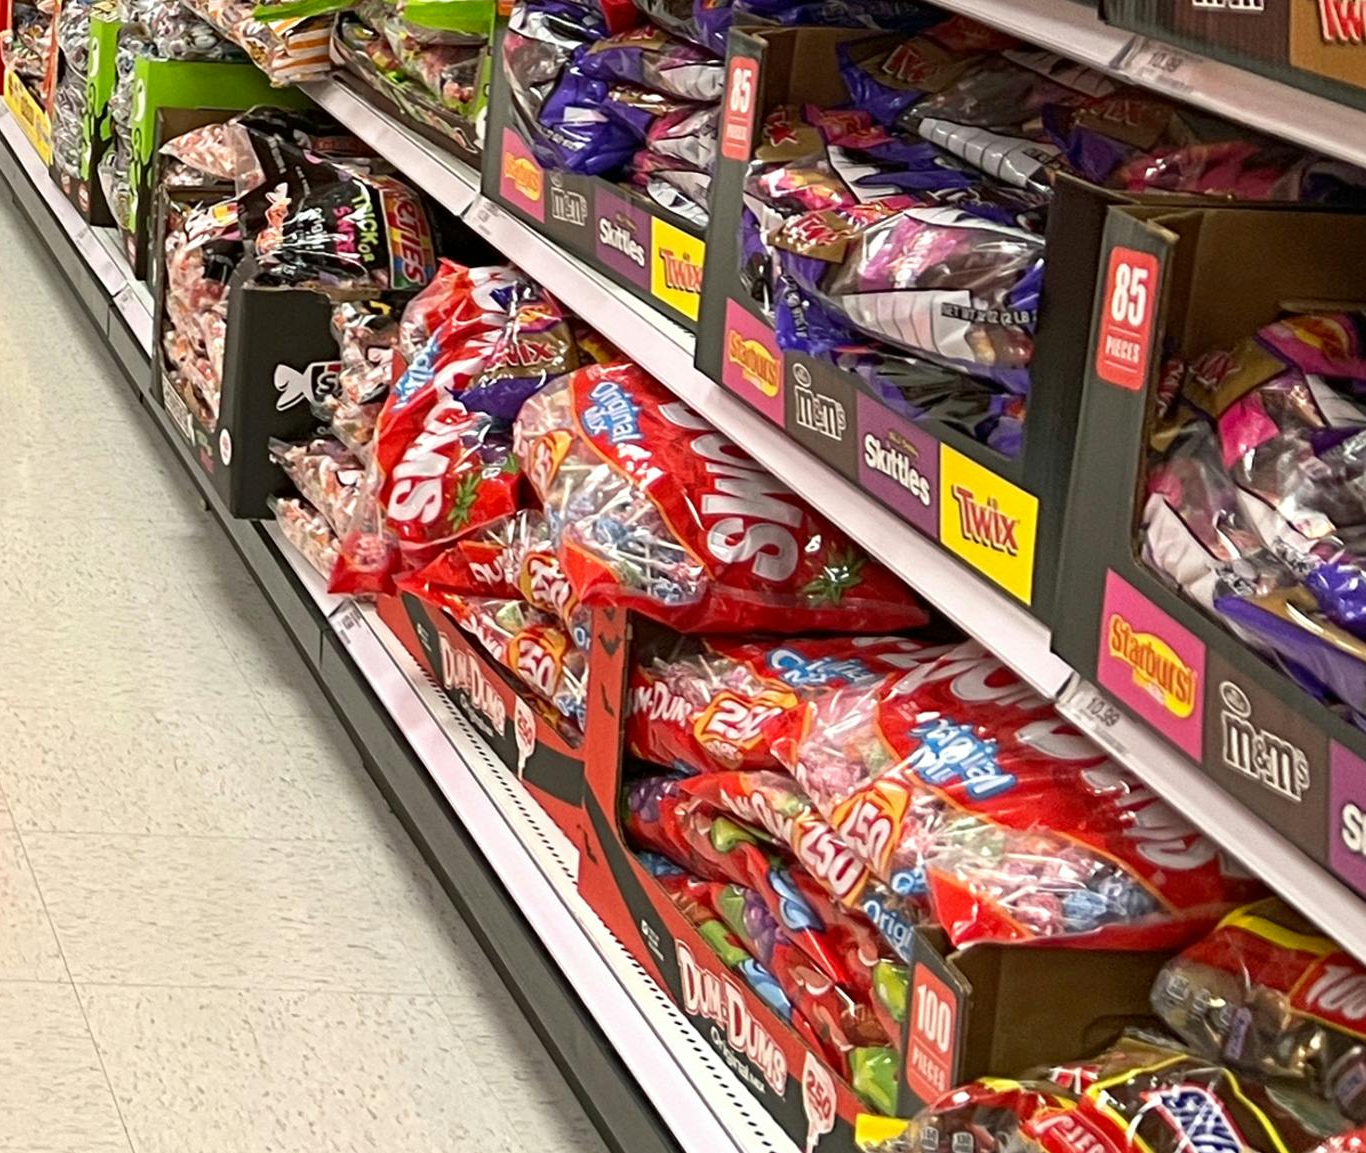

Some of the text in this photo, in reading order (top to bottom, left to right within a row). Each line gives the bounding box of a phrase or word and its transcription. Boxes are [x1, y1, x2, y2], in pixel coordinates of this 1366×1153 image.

[729, 66, 753, 114] 85
[599, 217, 645, 267] Skittles
[1111, 260, 1149, 328] 85
[1105, 333, 1141, 365] PIECES
[864, 434, 931, 507] Skittles
[953, 484, 1019, 557] Twix
[1110, 615, 1196, 706] Starburst
[917, 984, 951, 1052] 100
[913, 1047, 945, 1090] PIECES
